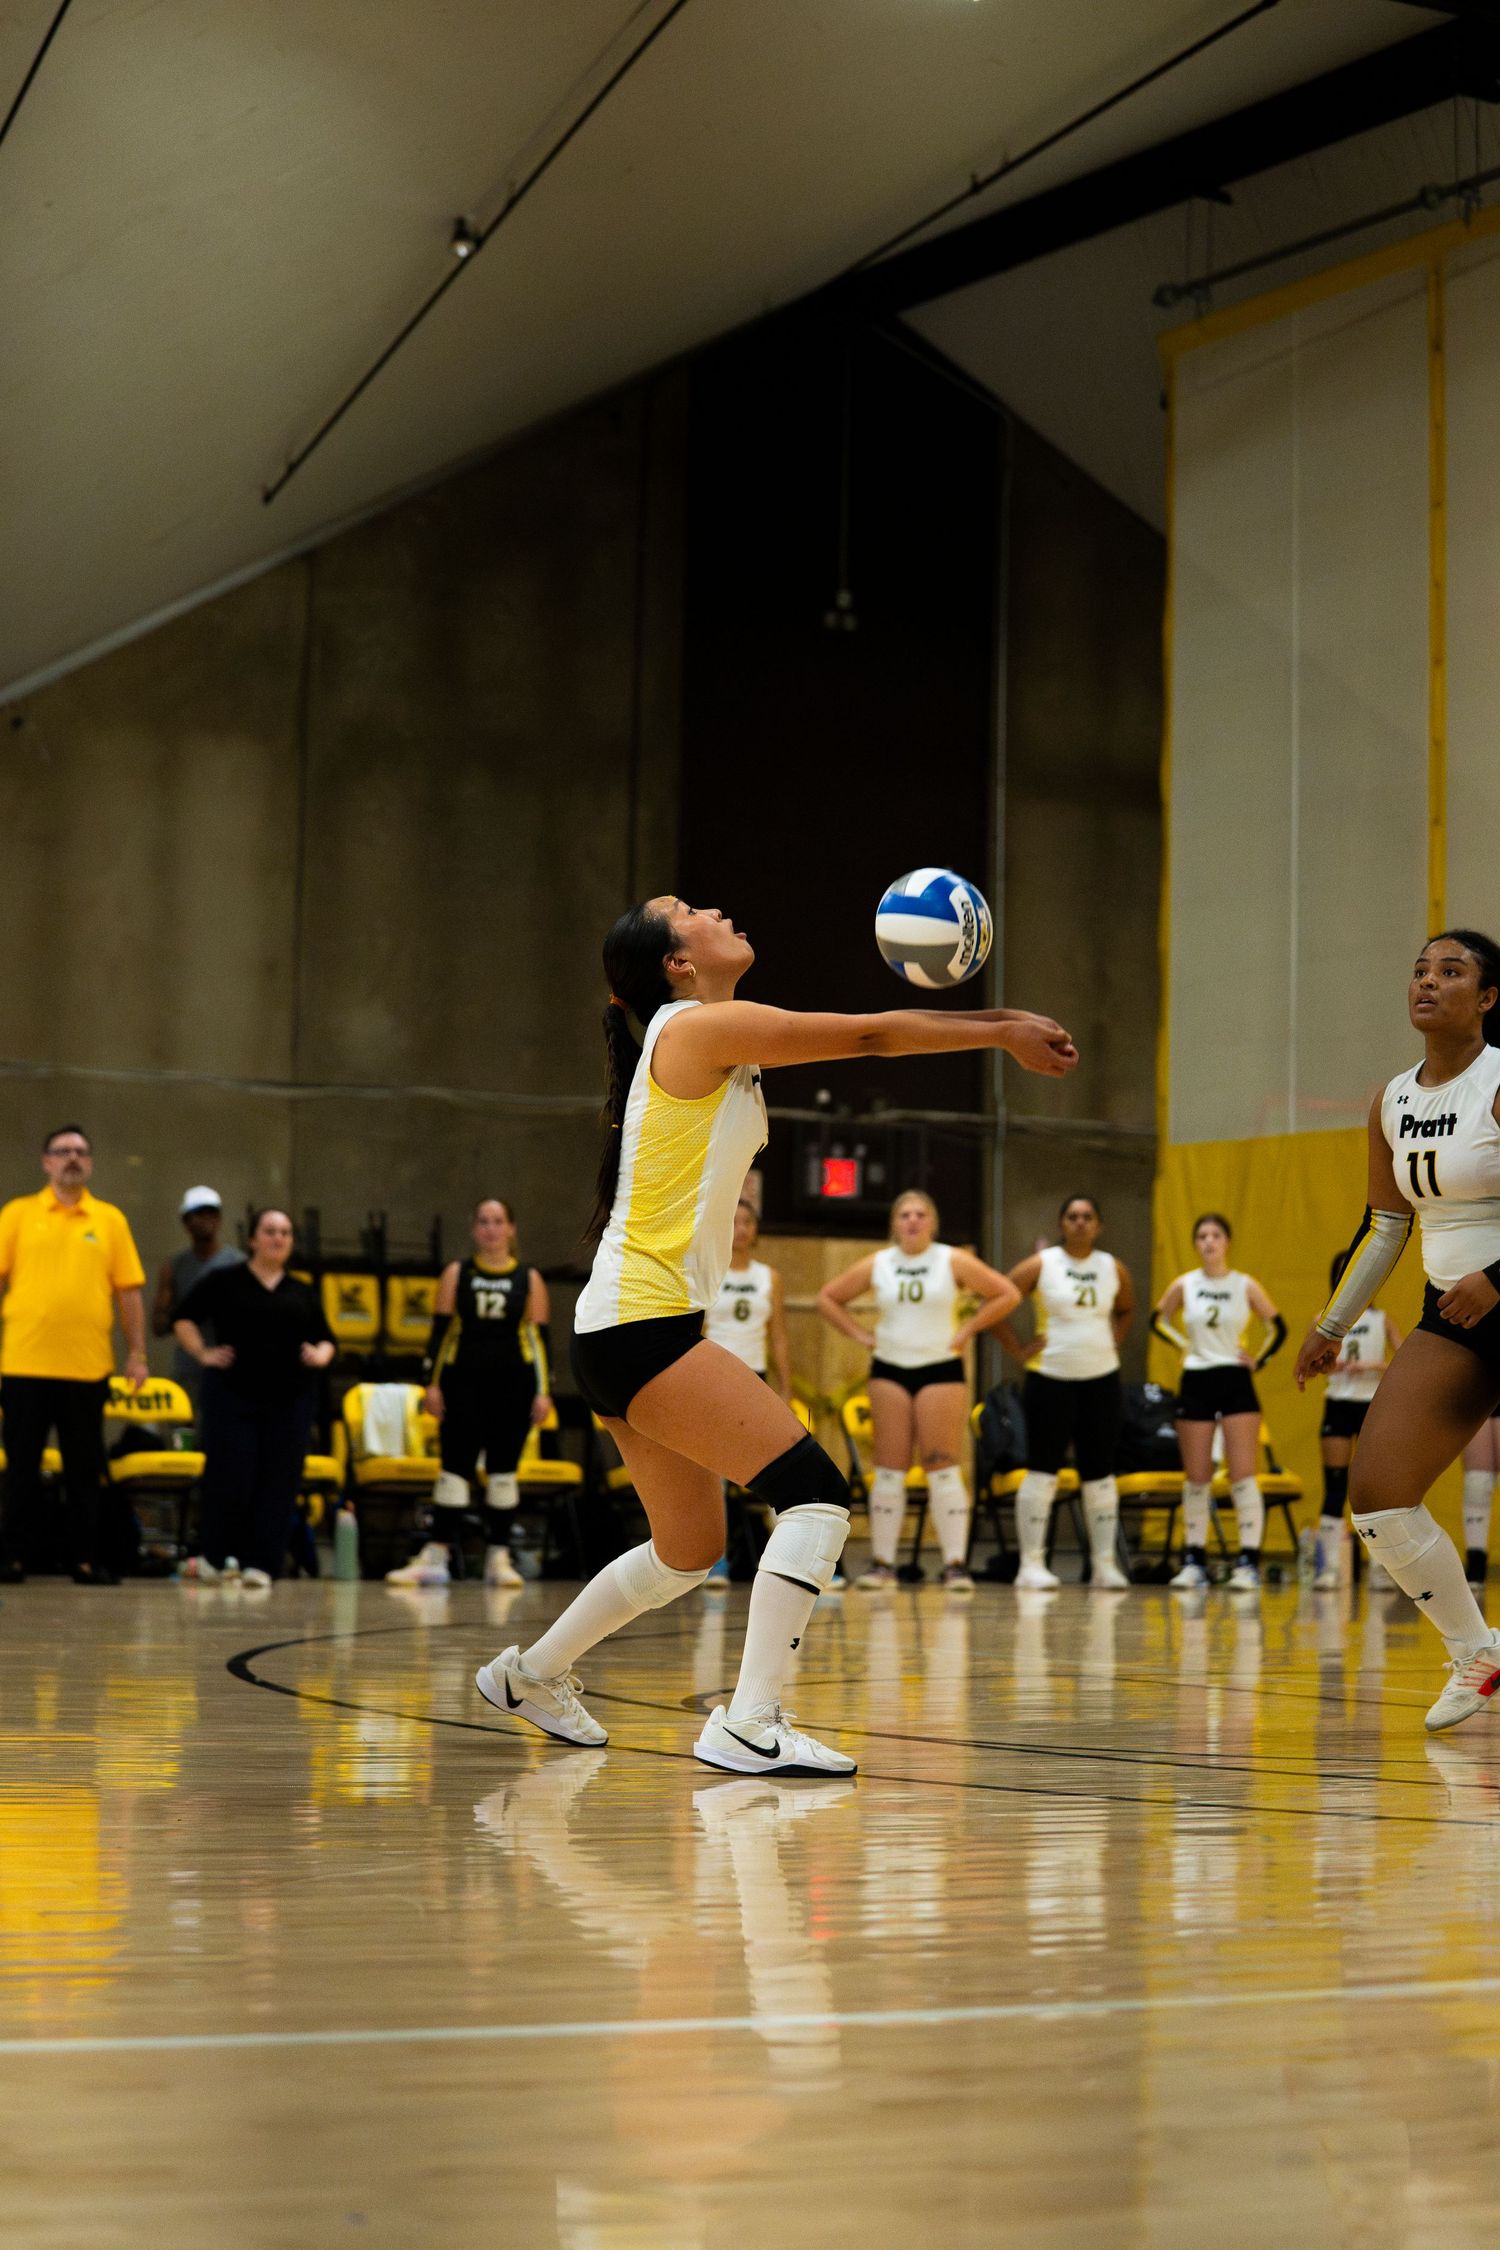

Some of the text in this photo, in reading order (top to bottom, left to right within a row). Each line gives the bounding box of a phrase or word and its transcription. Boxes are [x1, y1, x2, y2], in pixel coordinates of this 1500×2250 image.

[959, 899, 975, 966] molten
[1399, 1113, 1458, 1139] Pratt
[1406, 1150, 1443, 1199] 11
[897, 1279, 926, 1304] 10
[1073, 1285, 1098, 1307] 21
[475, 1291, 508, 1319] 12
[733, 1299, 752, 1322] 6
[1205, 1305, 1221, 1329] 2
[107, 1387, 174, 1411] Pratt
